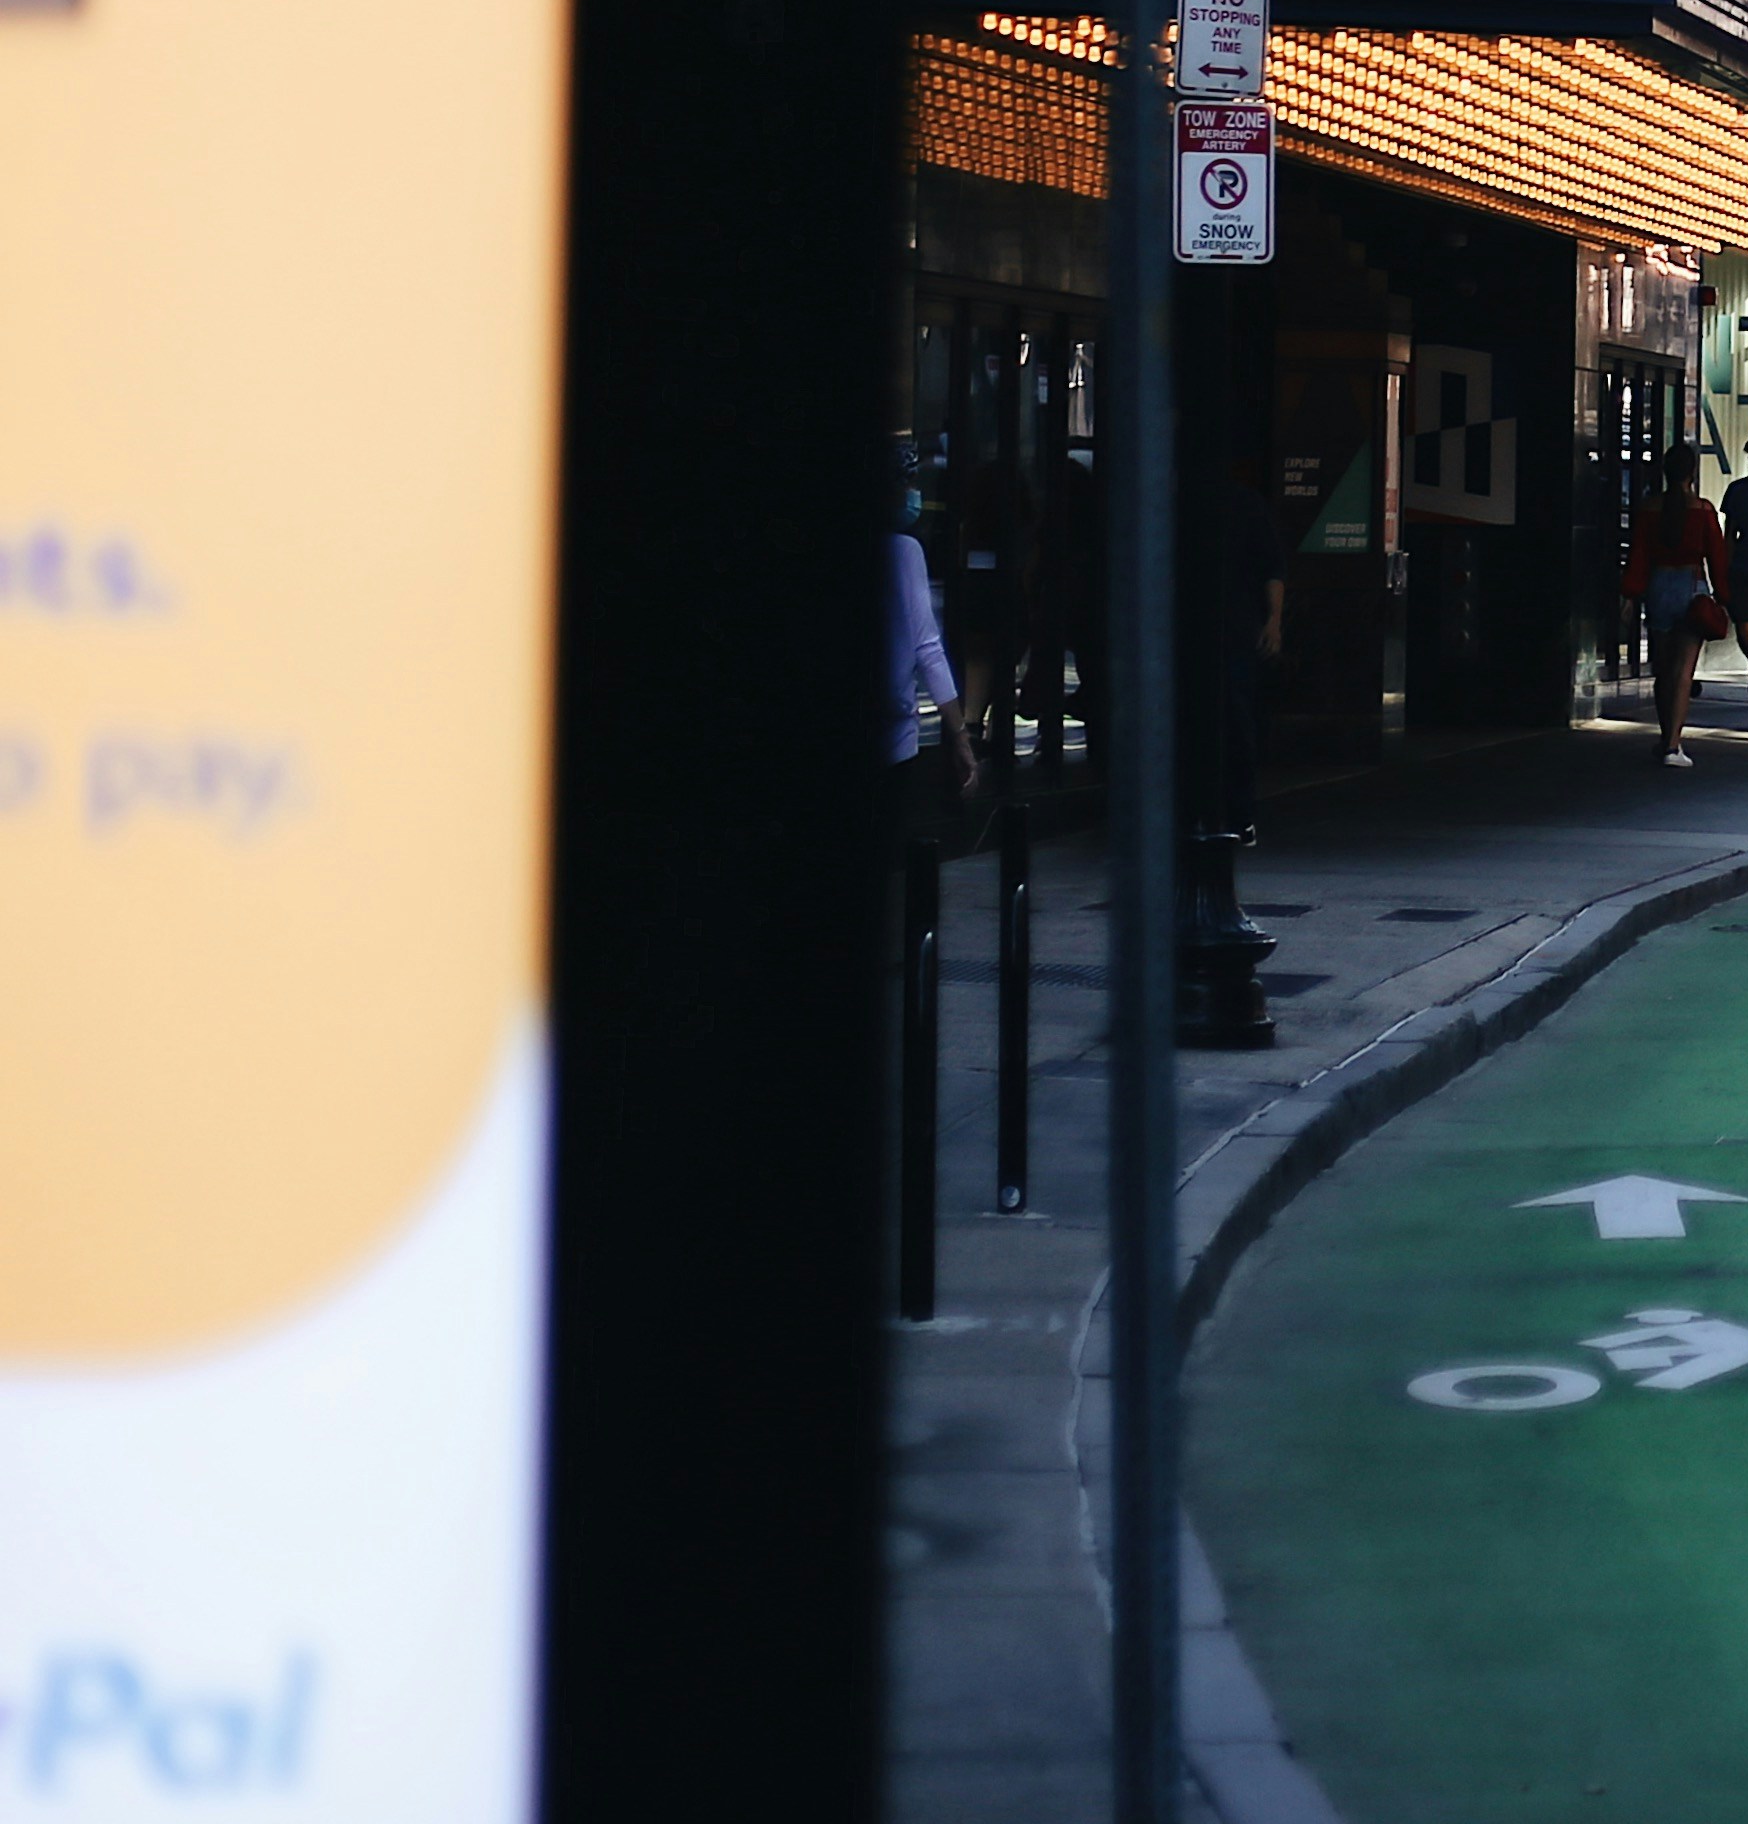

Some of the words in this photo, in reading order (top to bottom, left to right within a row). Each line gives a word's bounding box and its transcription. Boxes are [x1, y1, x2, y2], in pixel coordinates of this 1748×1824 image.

[1189, 7, 1261, 28] STOPPING
[1212, 26, 1241, 41] ANY
[1210, 39, 1242, 56] TIME
[1183, 109, 1218, 128] TOW
[1225, 110, 1266, 129] ZONE
[1189, 128, 1259, 142] EMERGENCY
[1201, 139, 1246, 152] ARTERY
[1199, 223, 1253, 241] SNOW
[1192, 239, 1260, 254] EMERGENCY
[1284, 457, 1320, 469] EXPLORE
[1284, 471, 1303, 482] NEW
[1284, 484, 1319, 496] WORLDS
[1324, 522, 1366, 534] DISCOVER
[0, 1646, 330, 1801] Pal
